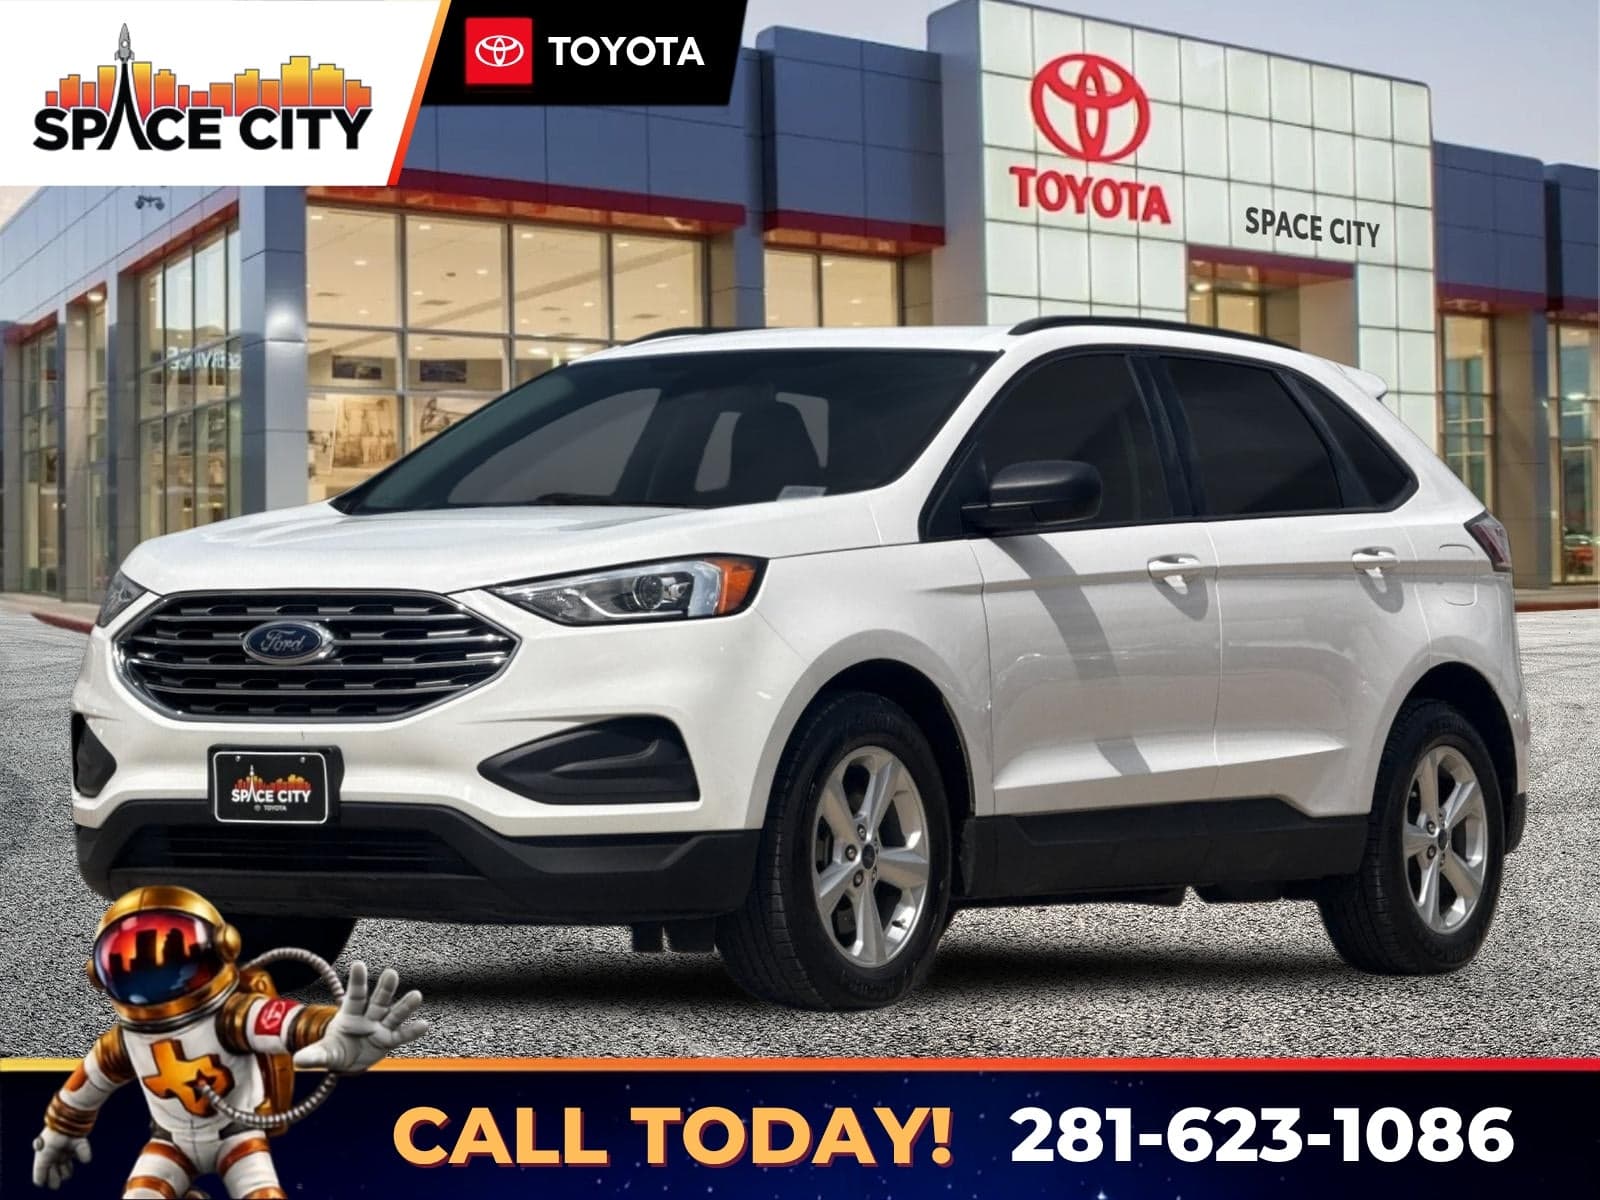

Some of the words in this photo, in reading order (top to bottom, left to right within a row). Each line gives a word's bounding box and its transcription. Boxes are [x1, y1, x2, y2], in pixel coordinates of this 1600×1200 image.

[1009, 166, 1171, 225] TOYOTA
[1245, 206, 1322, 242] SPACE
[1329, 217, 1381, 249] CITY
[260, 629, 304, 651] Ford
[277, 789, 312, 803] CITY
[263, 804, 287, 812] TOYOTA
